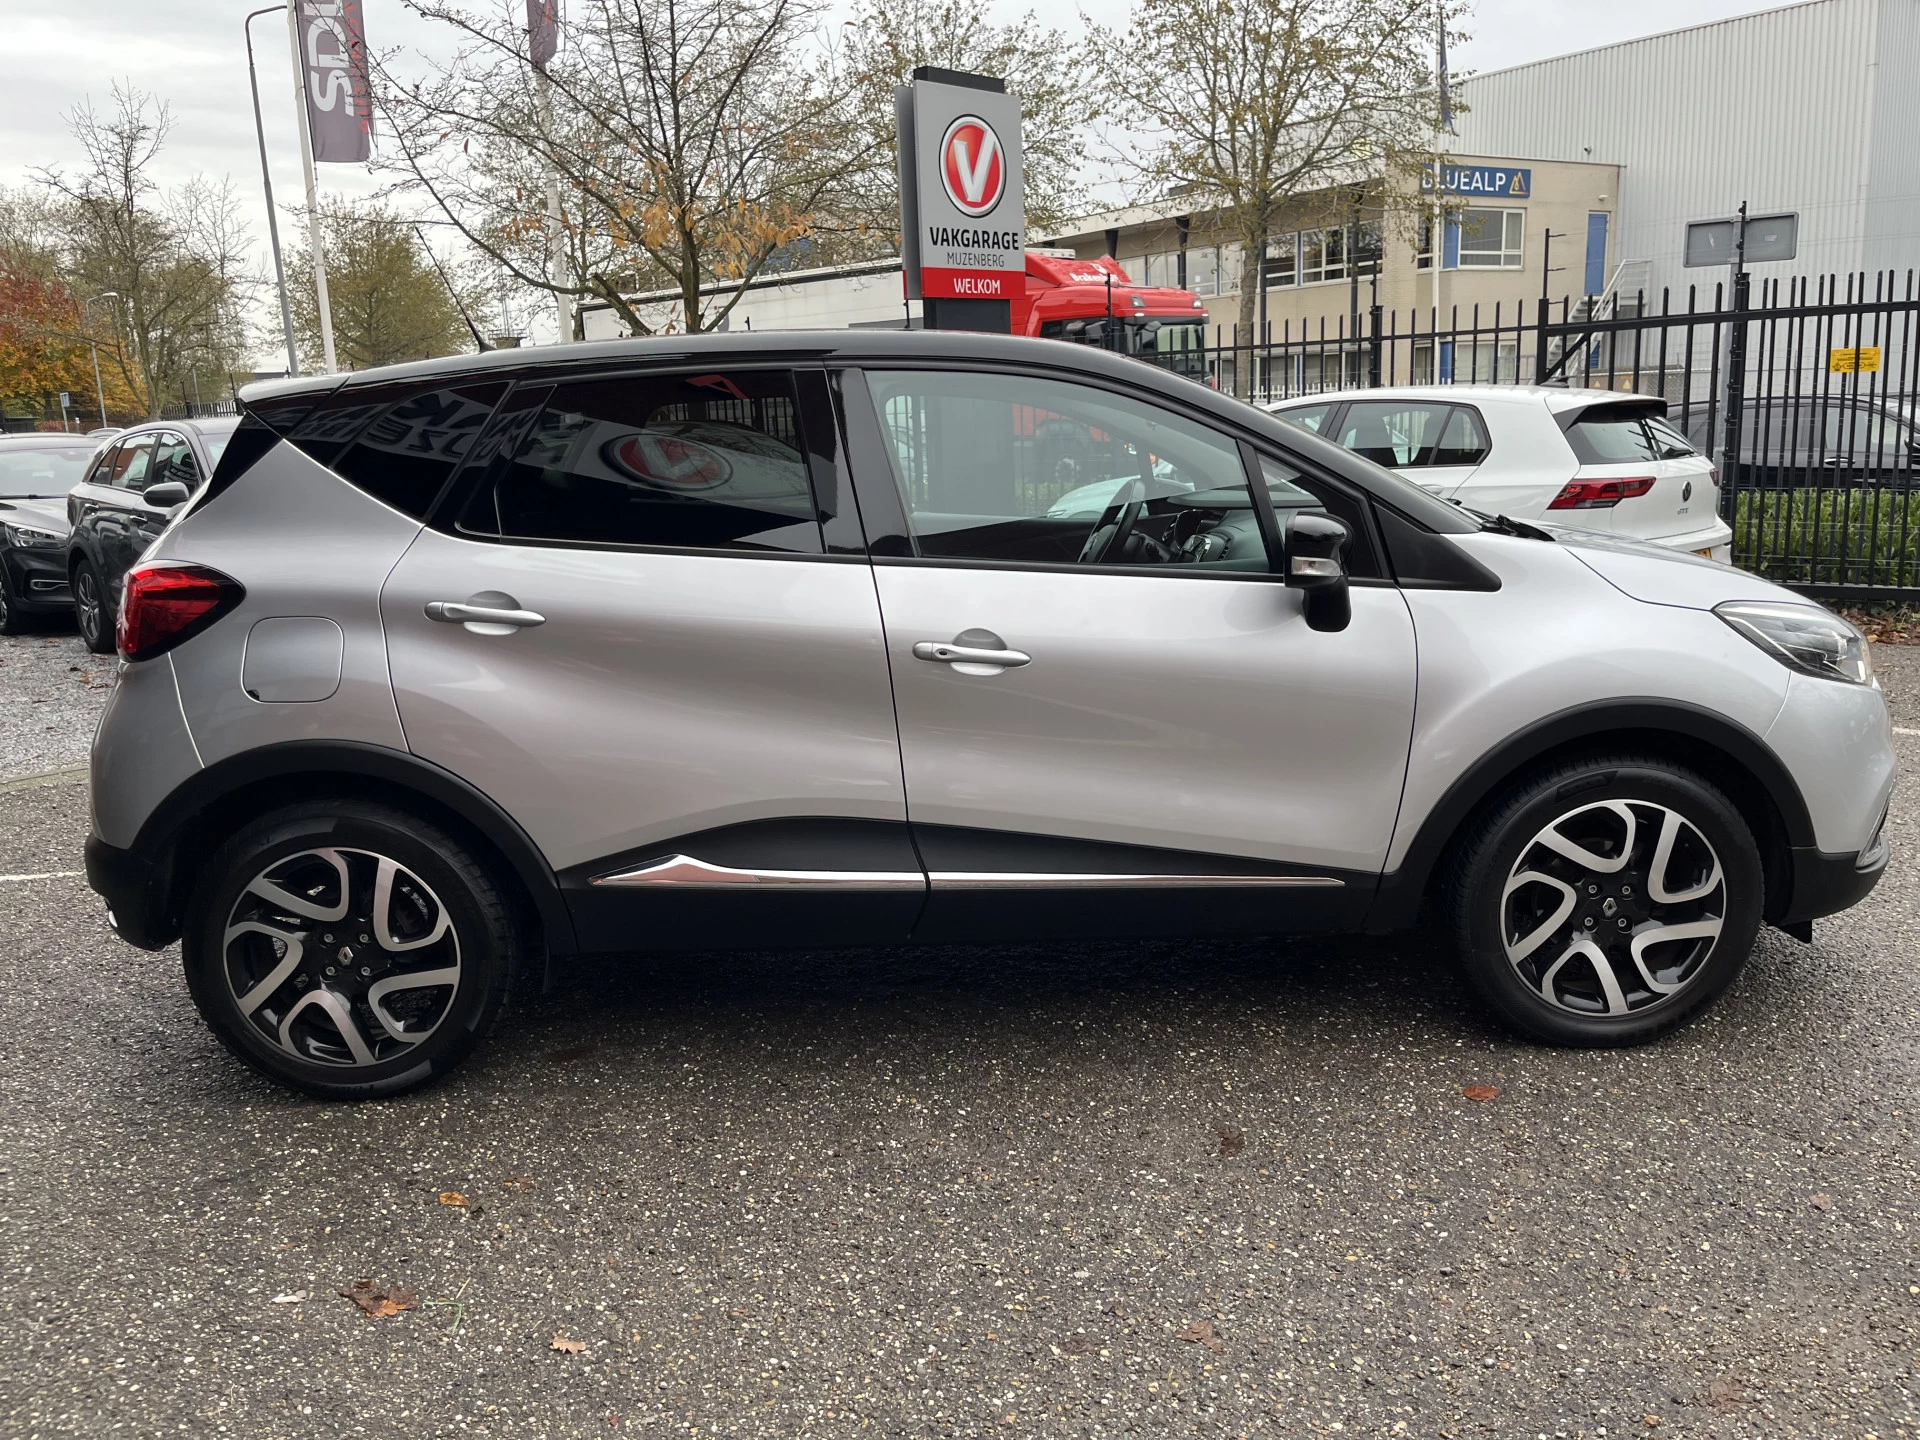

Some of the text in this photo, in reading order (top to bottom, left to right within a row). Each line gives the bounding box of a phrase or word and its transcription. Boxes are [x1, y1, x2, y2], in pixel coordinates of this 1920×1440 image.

[1422, 168, 1506, 192] BLUEALP
[929, 226, 1019, 251] VAKGARAGE
[947, 252, 1005, 268] MUZENBERG
[953, 278, 1001, 294] WELKOM
